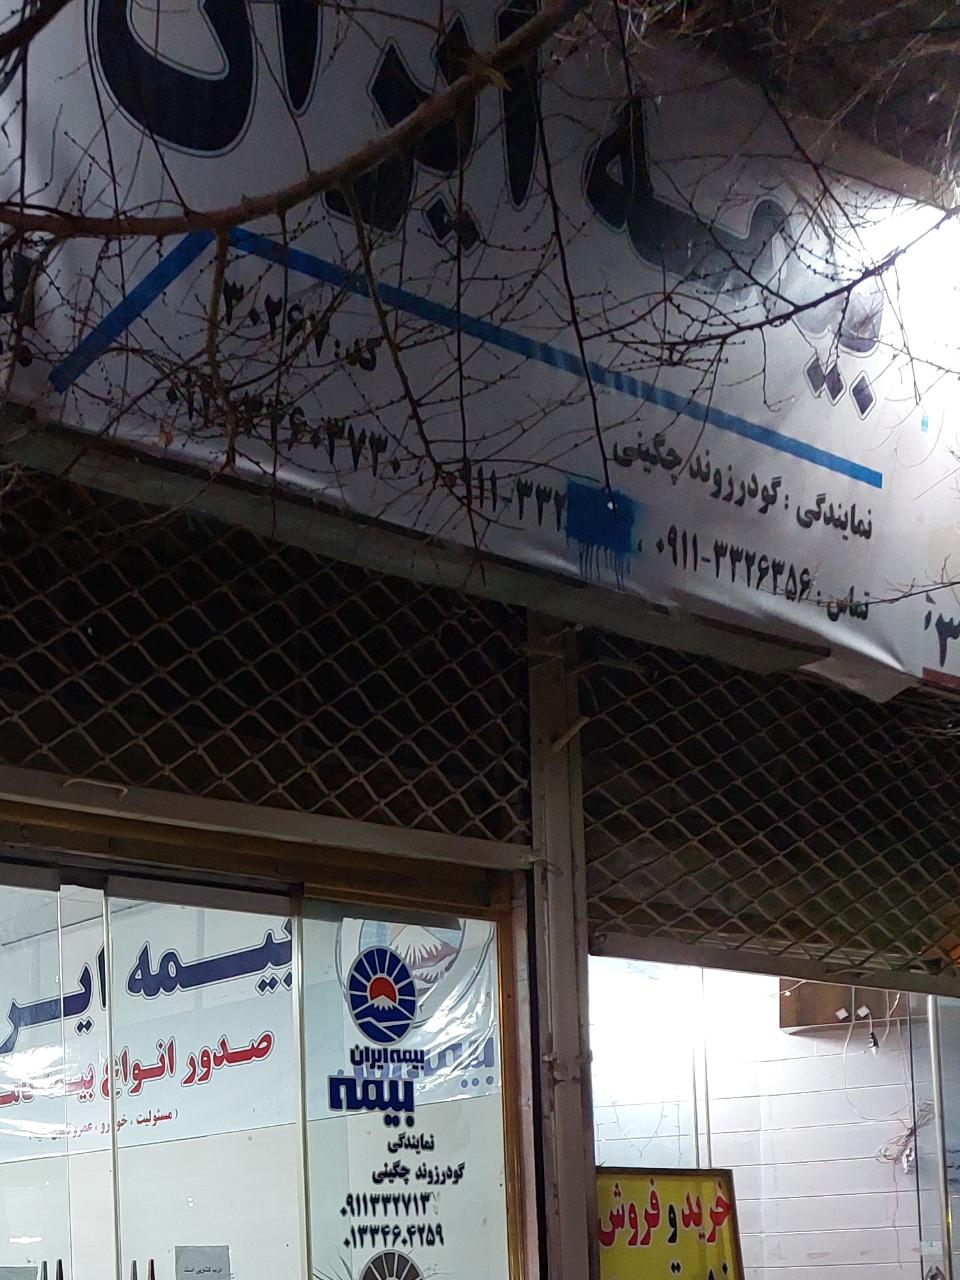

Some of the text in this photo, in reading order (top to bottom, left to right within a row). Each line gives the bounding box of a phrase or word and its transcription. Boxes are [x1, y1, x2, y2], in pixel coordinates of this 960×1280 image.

[181, 1029, 275, 1088] صدور
[328, 1075, 416, 1128] بیمه
[100, 1114, 128, 1134] خورو
[387, 1133, 435, 1154] نمایندگی
[371, 1160, 465, 1186] گودرزوند چگینی
[597, 1177, 732, 1248] خرید و فروش
[343, 1222, 445, 1250] ۰۱۳۳۴۶۰۴۲۵۹
